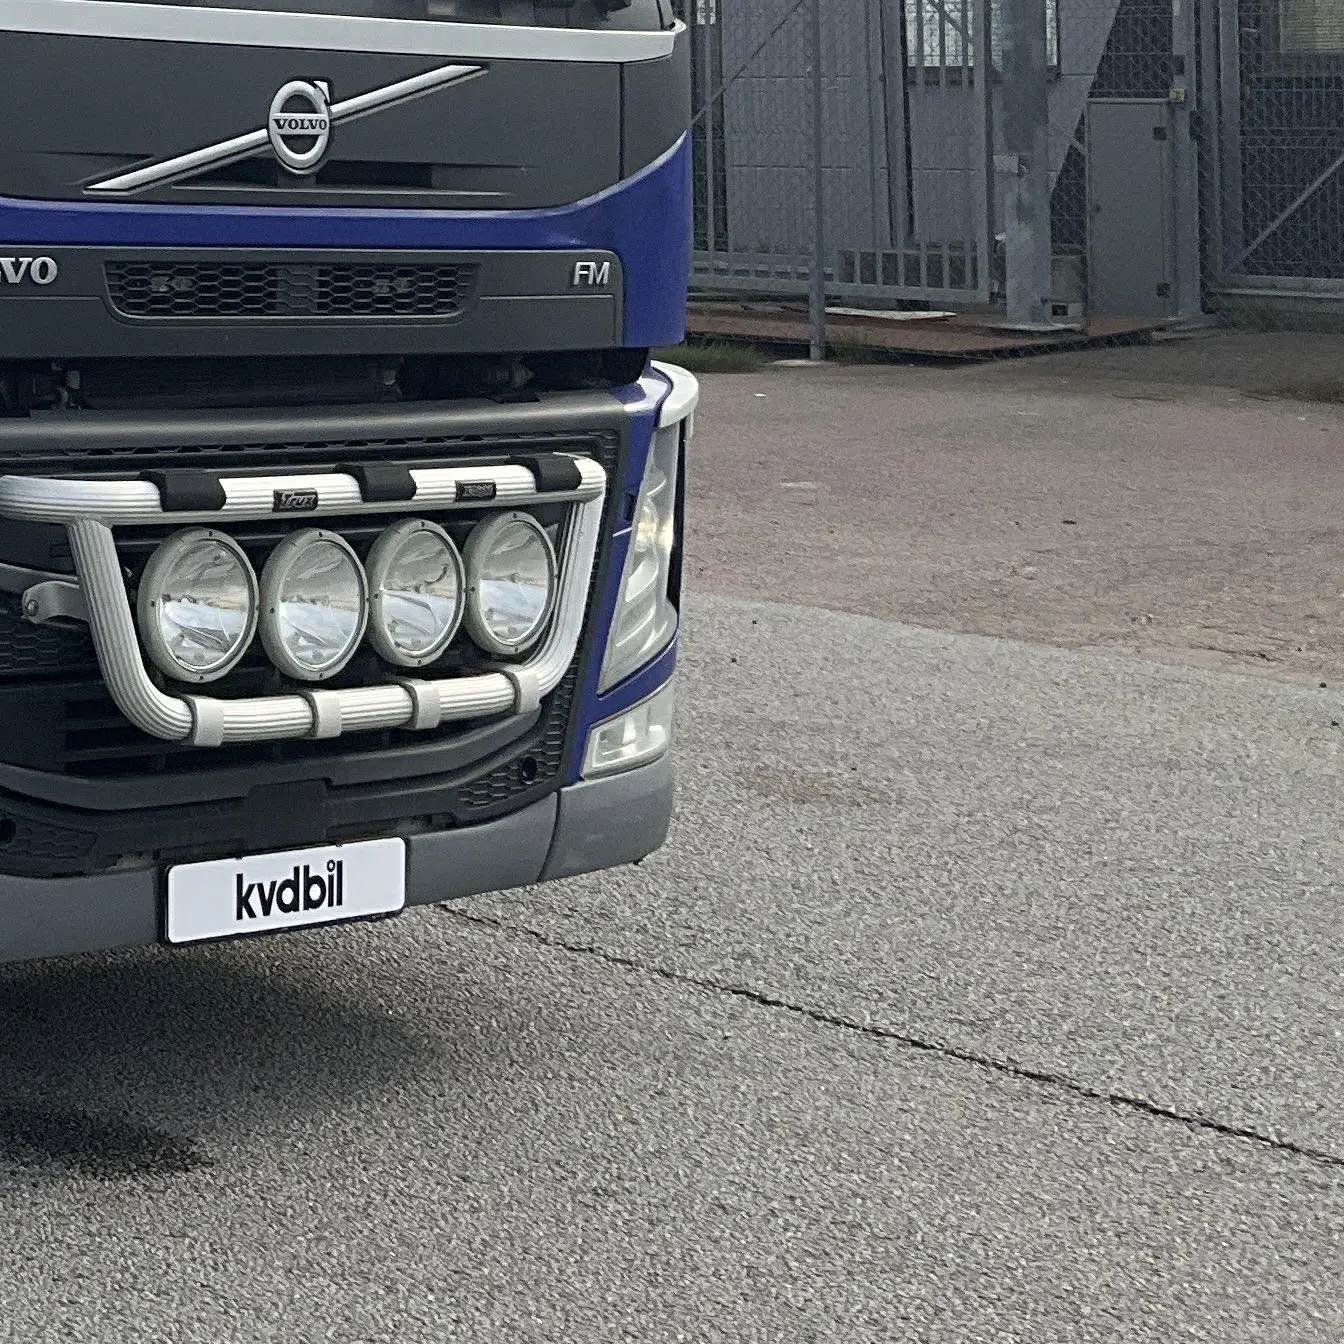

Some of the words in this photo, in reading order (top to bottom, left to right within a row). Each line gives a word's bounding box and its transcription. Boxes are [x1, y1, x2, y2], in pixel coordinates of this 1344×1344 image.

[272, 118, 328, 131] VOLVO
[574, 261, 610, 285] FM
[235, 859, 344, 921] kvdbil
